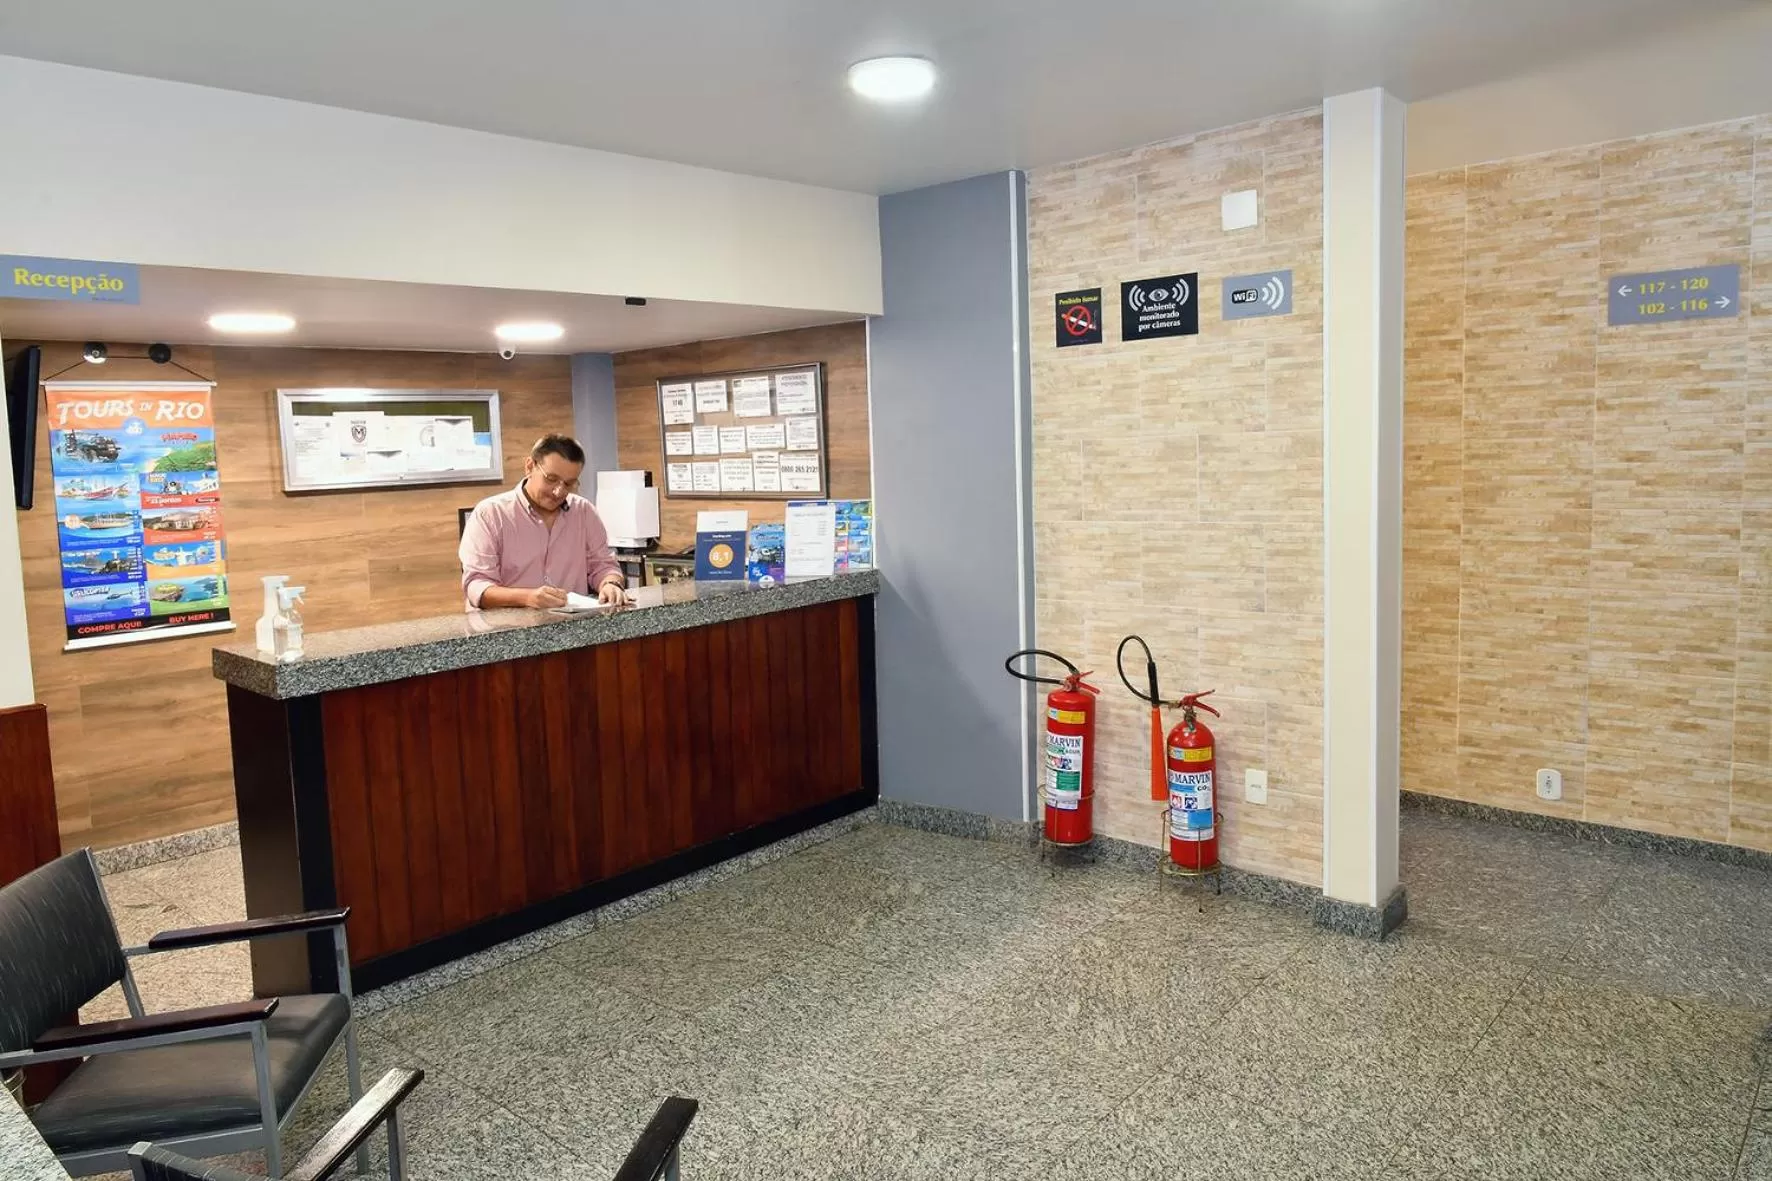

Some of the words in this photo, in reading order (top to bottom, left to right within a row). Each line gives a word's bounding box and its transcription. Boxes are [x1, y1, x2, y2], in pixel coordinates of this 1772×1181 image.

[14, 267, 124, 295] Recepção
[1639, 281, 1665, 295] 117
[1682, 277, 1709, 291] 120
[1141, 302, 1176, 313] Ambiente
[1639, 302, 1665, 315] 102
[1681, 298, 1708, 312] 116
[1139, 311, 1180, 322] monitorado
[1138, 322, 1151, 332] por
[1151, 319, 1181, 329] câmeras
[56, 399, 134, 425] TOURS
[155, 400, 205, 421] RIO
[168, 615, 186, 624] BUY
[188, 612, 209, 621] HERE
[77, 622, 116, 634] COMPRE
[1047, 735, 1081, 747] MARVIN
[1174, 772, 1210, 784] MARVIN
